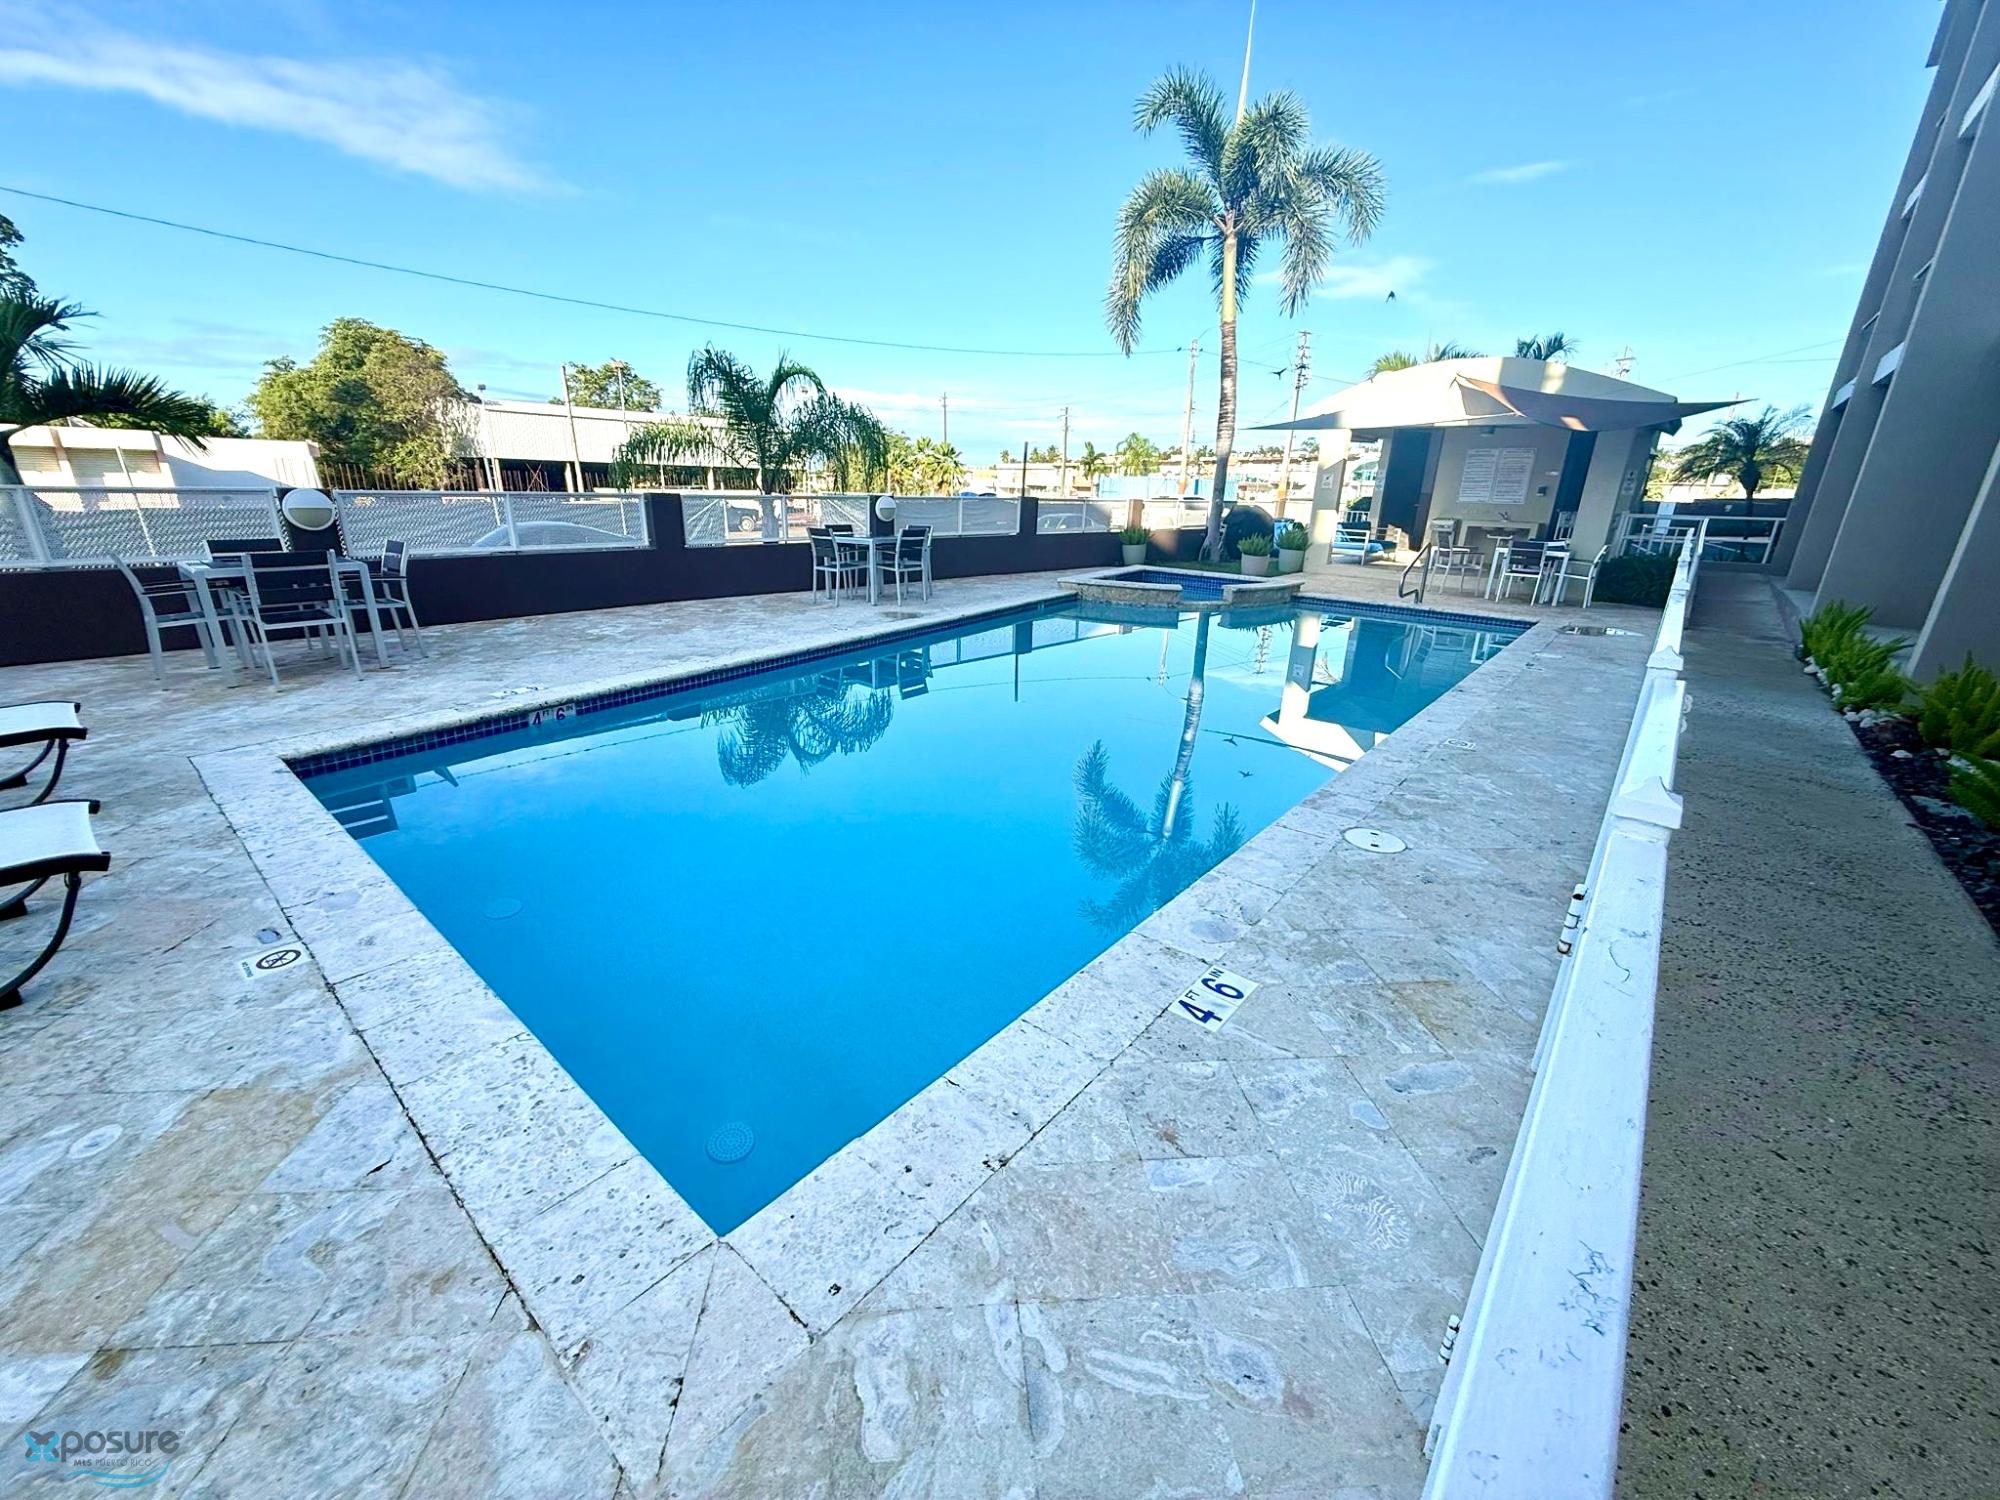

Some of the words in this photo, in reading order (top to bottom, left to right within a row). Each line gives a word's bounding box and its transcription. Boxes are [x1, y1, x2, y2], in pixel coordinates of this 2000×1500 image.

[556, 707, 566, 721] 6
[1208, 968, 1225, 979] IN
[1185, 989, 1200, 1001] FT
[1201, 978, 1244, 1000] 6
[1178, 999, 1223, 1023] 4
